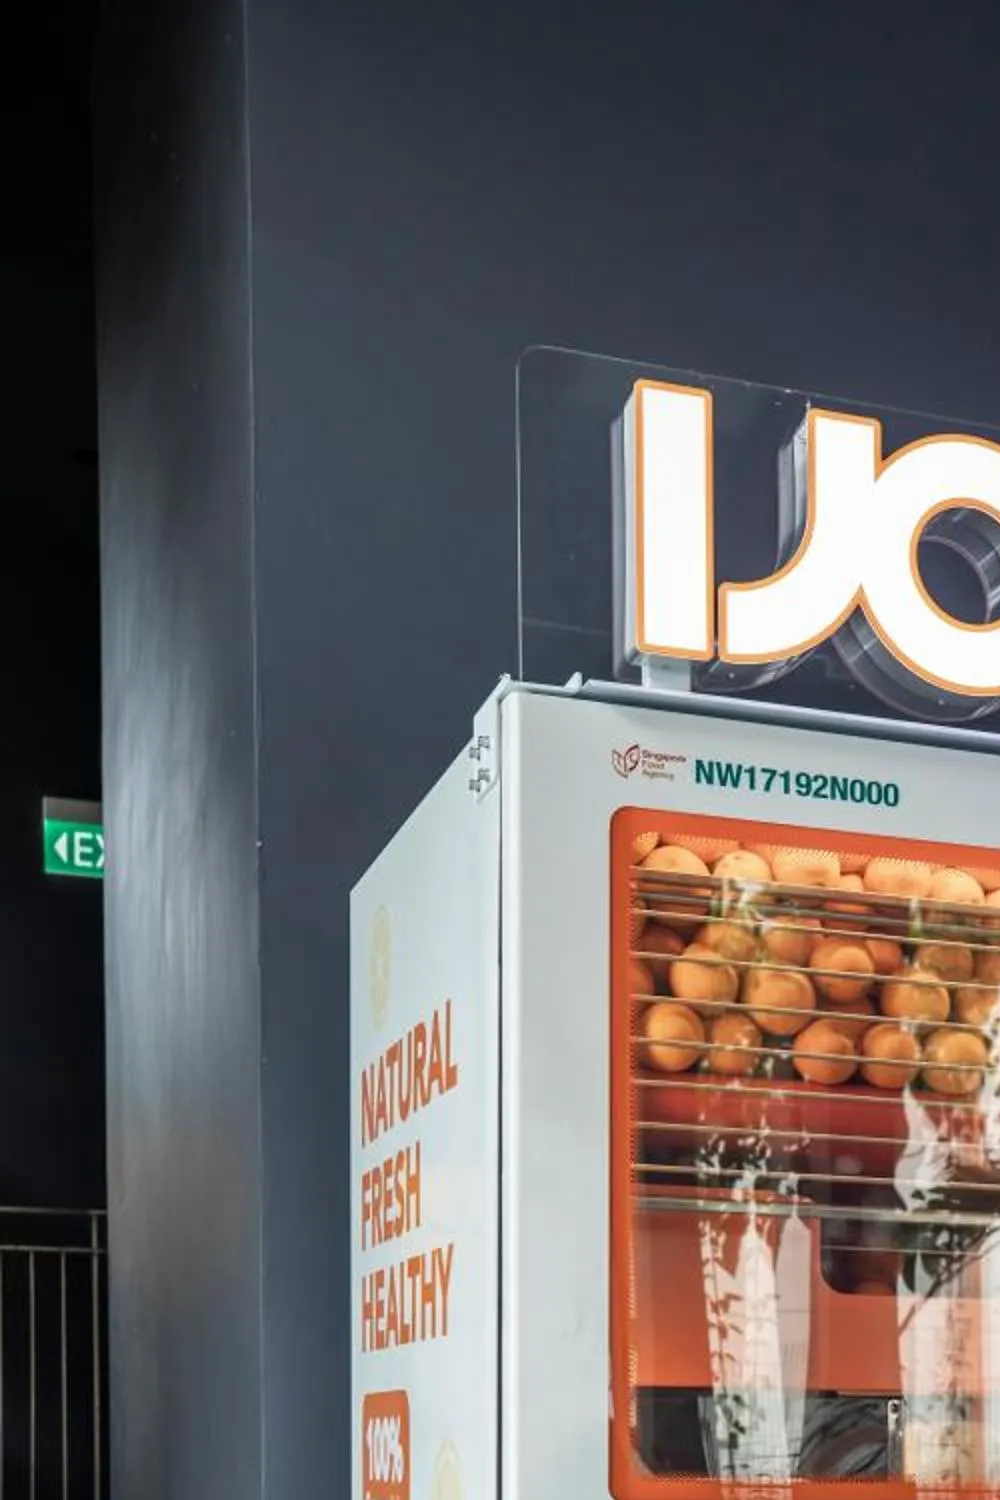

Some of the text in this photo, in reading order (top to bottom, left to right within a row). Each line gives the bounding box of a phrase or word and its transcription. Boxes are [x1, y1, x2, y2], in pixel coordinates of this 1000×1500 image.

[694, 758, 900, 807] NW17192N000
[360, 997, 459, 1148] NATURAL
[360, 1139, 422, 1252] FRESH
[360, 1242, 455, 1354] HEALTHY
[366, 1415, 405, 1484] 100%
